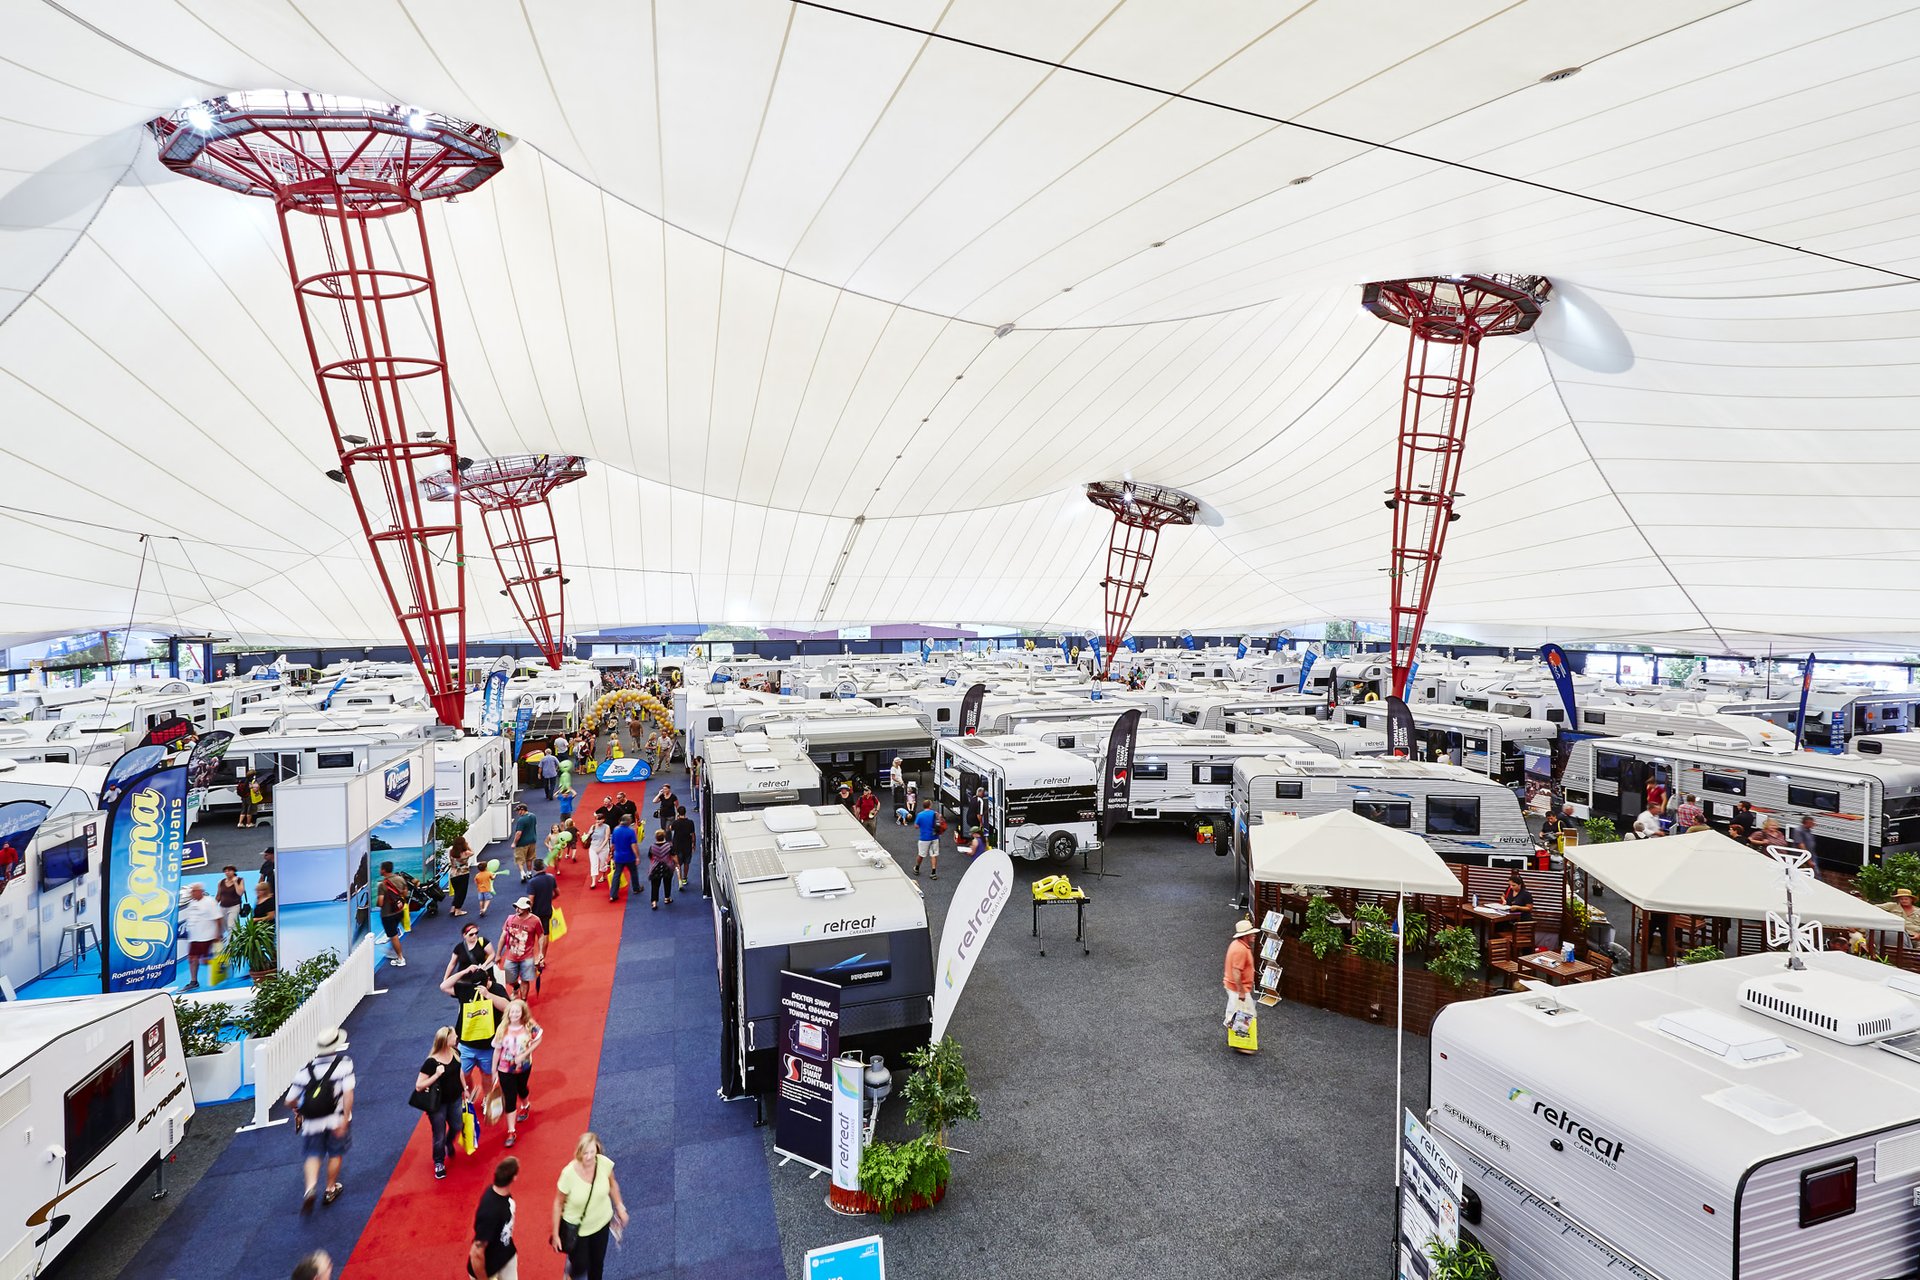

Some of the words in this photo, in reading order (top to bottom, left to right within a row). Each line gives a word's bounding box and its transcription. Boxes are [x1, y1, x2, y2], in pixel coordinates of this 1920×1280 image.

[758, 779, 790, 788] retreat
[1043, 776, 1071, 785] retreat
[168, 798, 182, 882] caravans
[114, 787, 174, 960] Roma
[957, 870, 1004, 960] retreat
[986, 886, 1008, 924] CARAVANS
[823, 915, 876, 934] retreat
[849, 928, 874, 936] CARAVANS
[111, 967, 145, 980] Roaming
[146, 958, 175, 973] Australia
[125, 974, 145, 986] Since
[782, 998, 807, 1011] CONTROL
[808, 1006, 838, 1020] ENHANCES
[791, 992, 813, 1004] DEXTER
[814, 998, 831, 1008] SWAY
[788, 1008, 810, 1020] TOWING
[810, 1014, 834, 1027] SAFETY
[803, 1062, 822, 1072] DEXTER
[803, 1069, 822, 1080] SWAY
[803, 1076, 832, 1091] CONTROL
[1443, 1102, 1512, 1152] SPINNAKER
[1533, 1100, 1625, 1163] retreat
[838, 1111, 849, 1169] retreat
[1420, 1134, 1459, 1184] retreat
[1573, 1141, 1617, 1171] CARAVANS
[1468, 1155, 1504, 1180] comfort
[1504, 1178, 1526, 1197] that
[1520, 1193, 1563, 1223] follows
[1564, 1222, 1587, 1240] you
